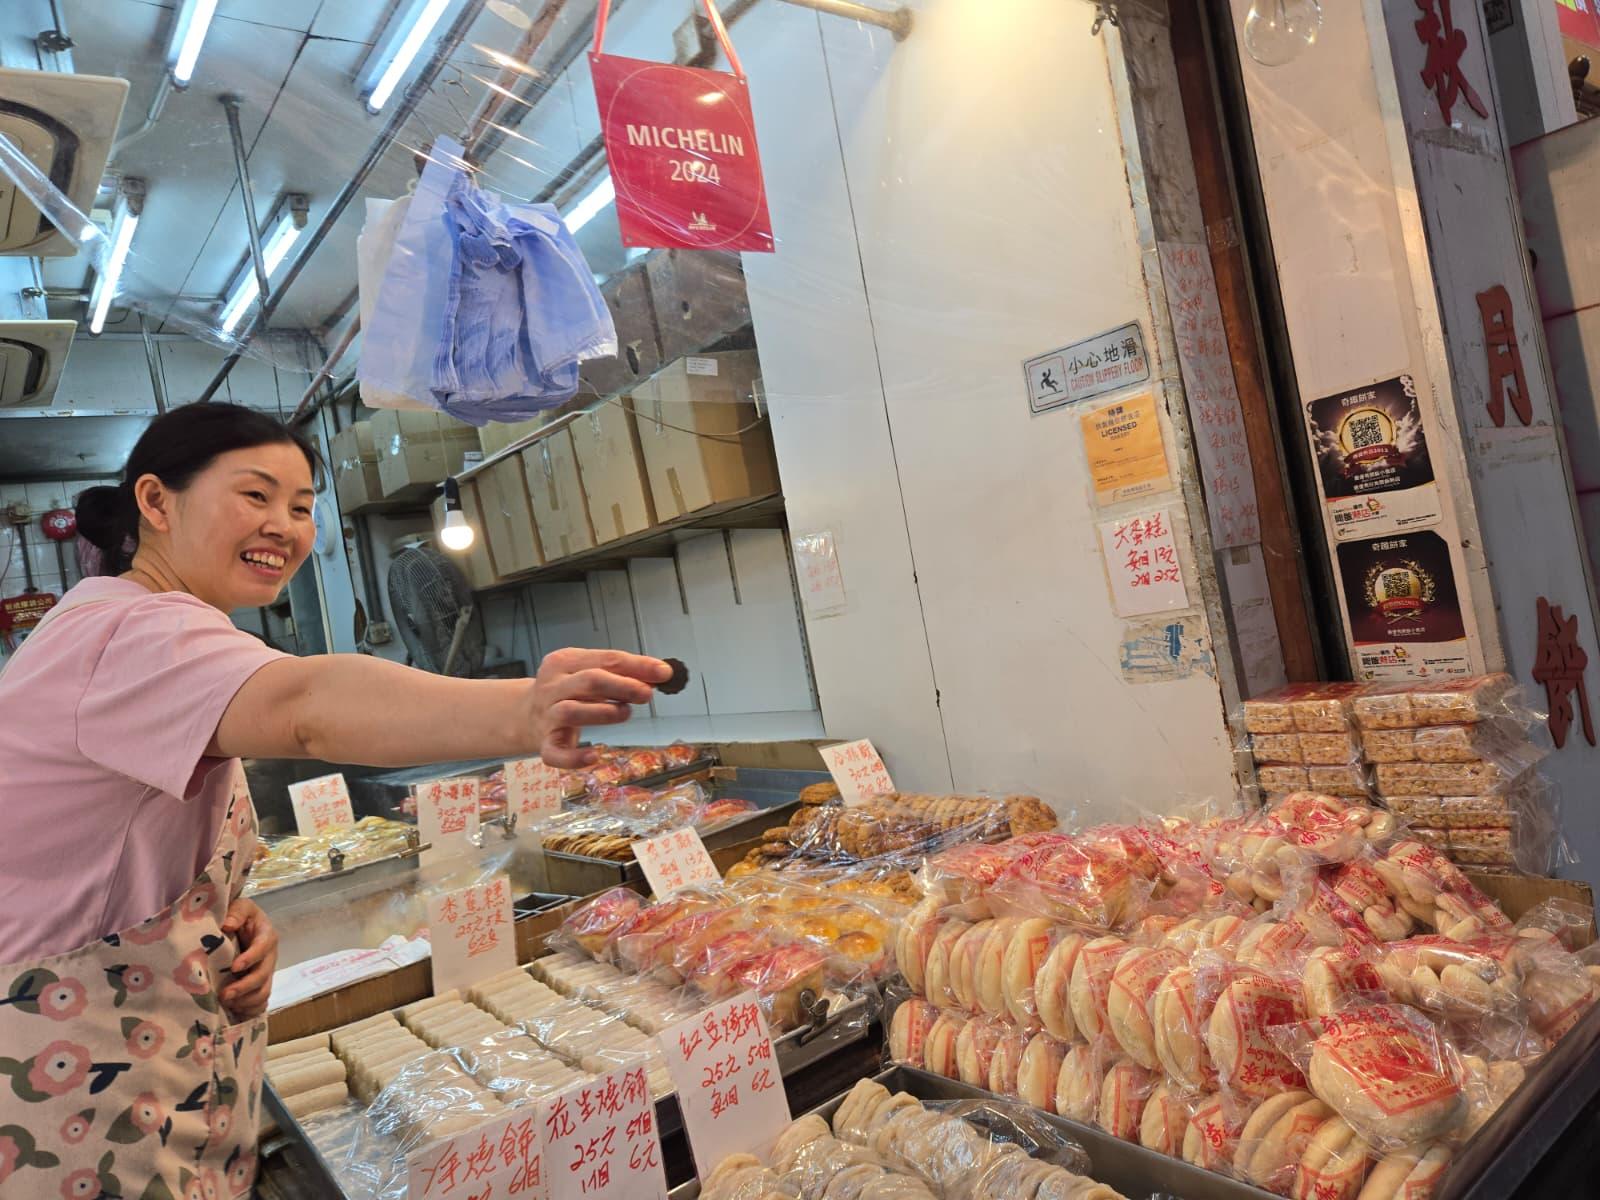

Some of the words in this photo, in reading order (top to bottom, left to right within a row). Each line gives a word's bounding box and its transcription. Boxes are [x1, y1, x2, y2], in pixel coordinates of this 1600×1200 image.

[626, 124, 744, 156] MICHELIN
[669, 160, 721, 184] 2024
[1068, 337, 1138, 376] 小心地滑
[1095, 364, 1123, 386] SLIPPERY
[1123, 356, 1145, 375] FLOOR
[1100, 421, 1138, 438] LICENSED
[1113, 512, 1168, 550] 大蛋糕
[701, 1053, 742, 1088] 25元
[751, 1068, 776, 1093] 6元
[546, 1066, 649, 1145] 花生燒餅
[569, 1125, 617, 1173] 25元
[628, 1138, 659, 1173] 6元
